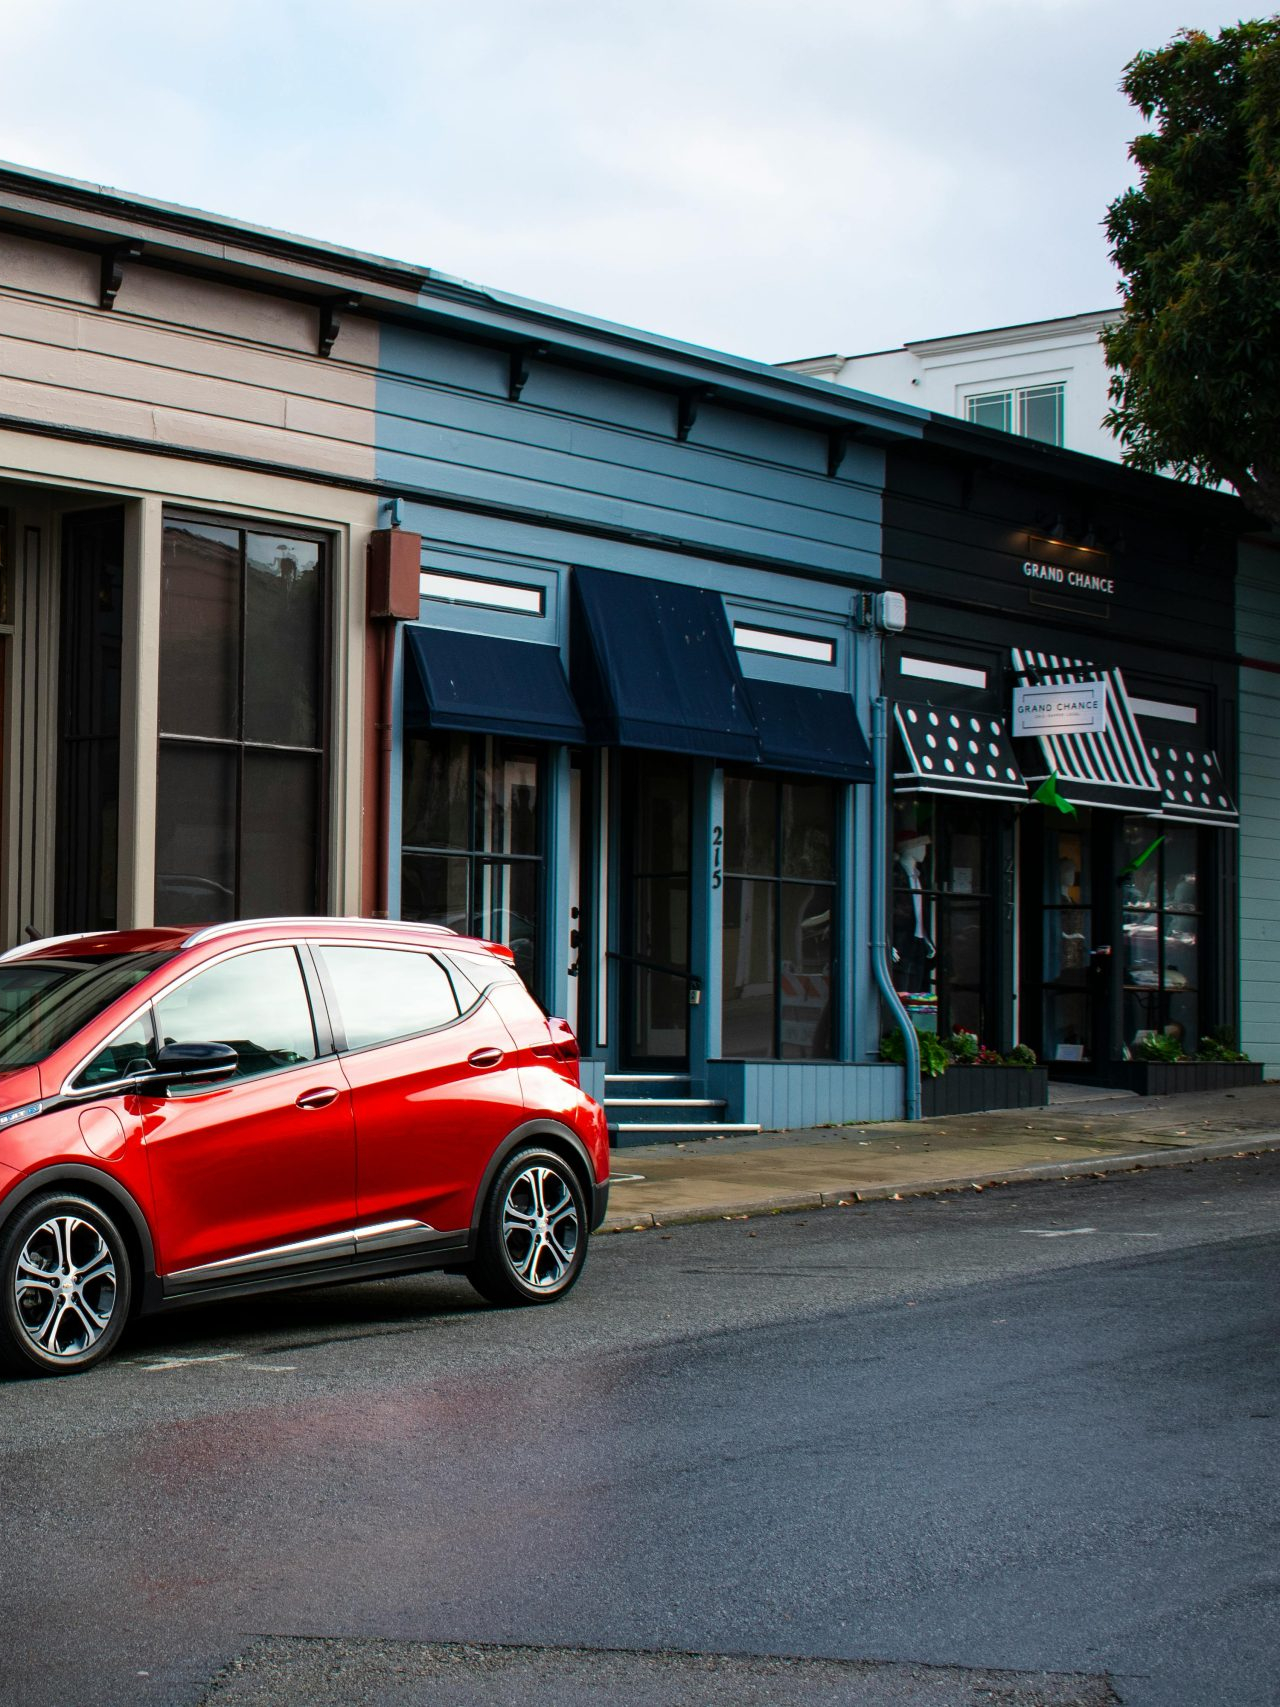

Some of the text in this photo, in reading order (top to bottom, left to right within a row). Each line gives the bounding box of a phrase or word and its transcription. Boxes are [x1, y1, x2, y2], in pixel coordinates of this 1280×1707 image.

[1023, 562, 1115, 594] GRAND CHANCE
[1017, 700, 1099, 714] GRAND CHANCE
[712, 825, 723, 889] 215
